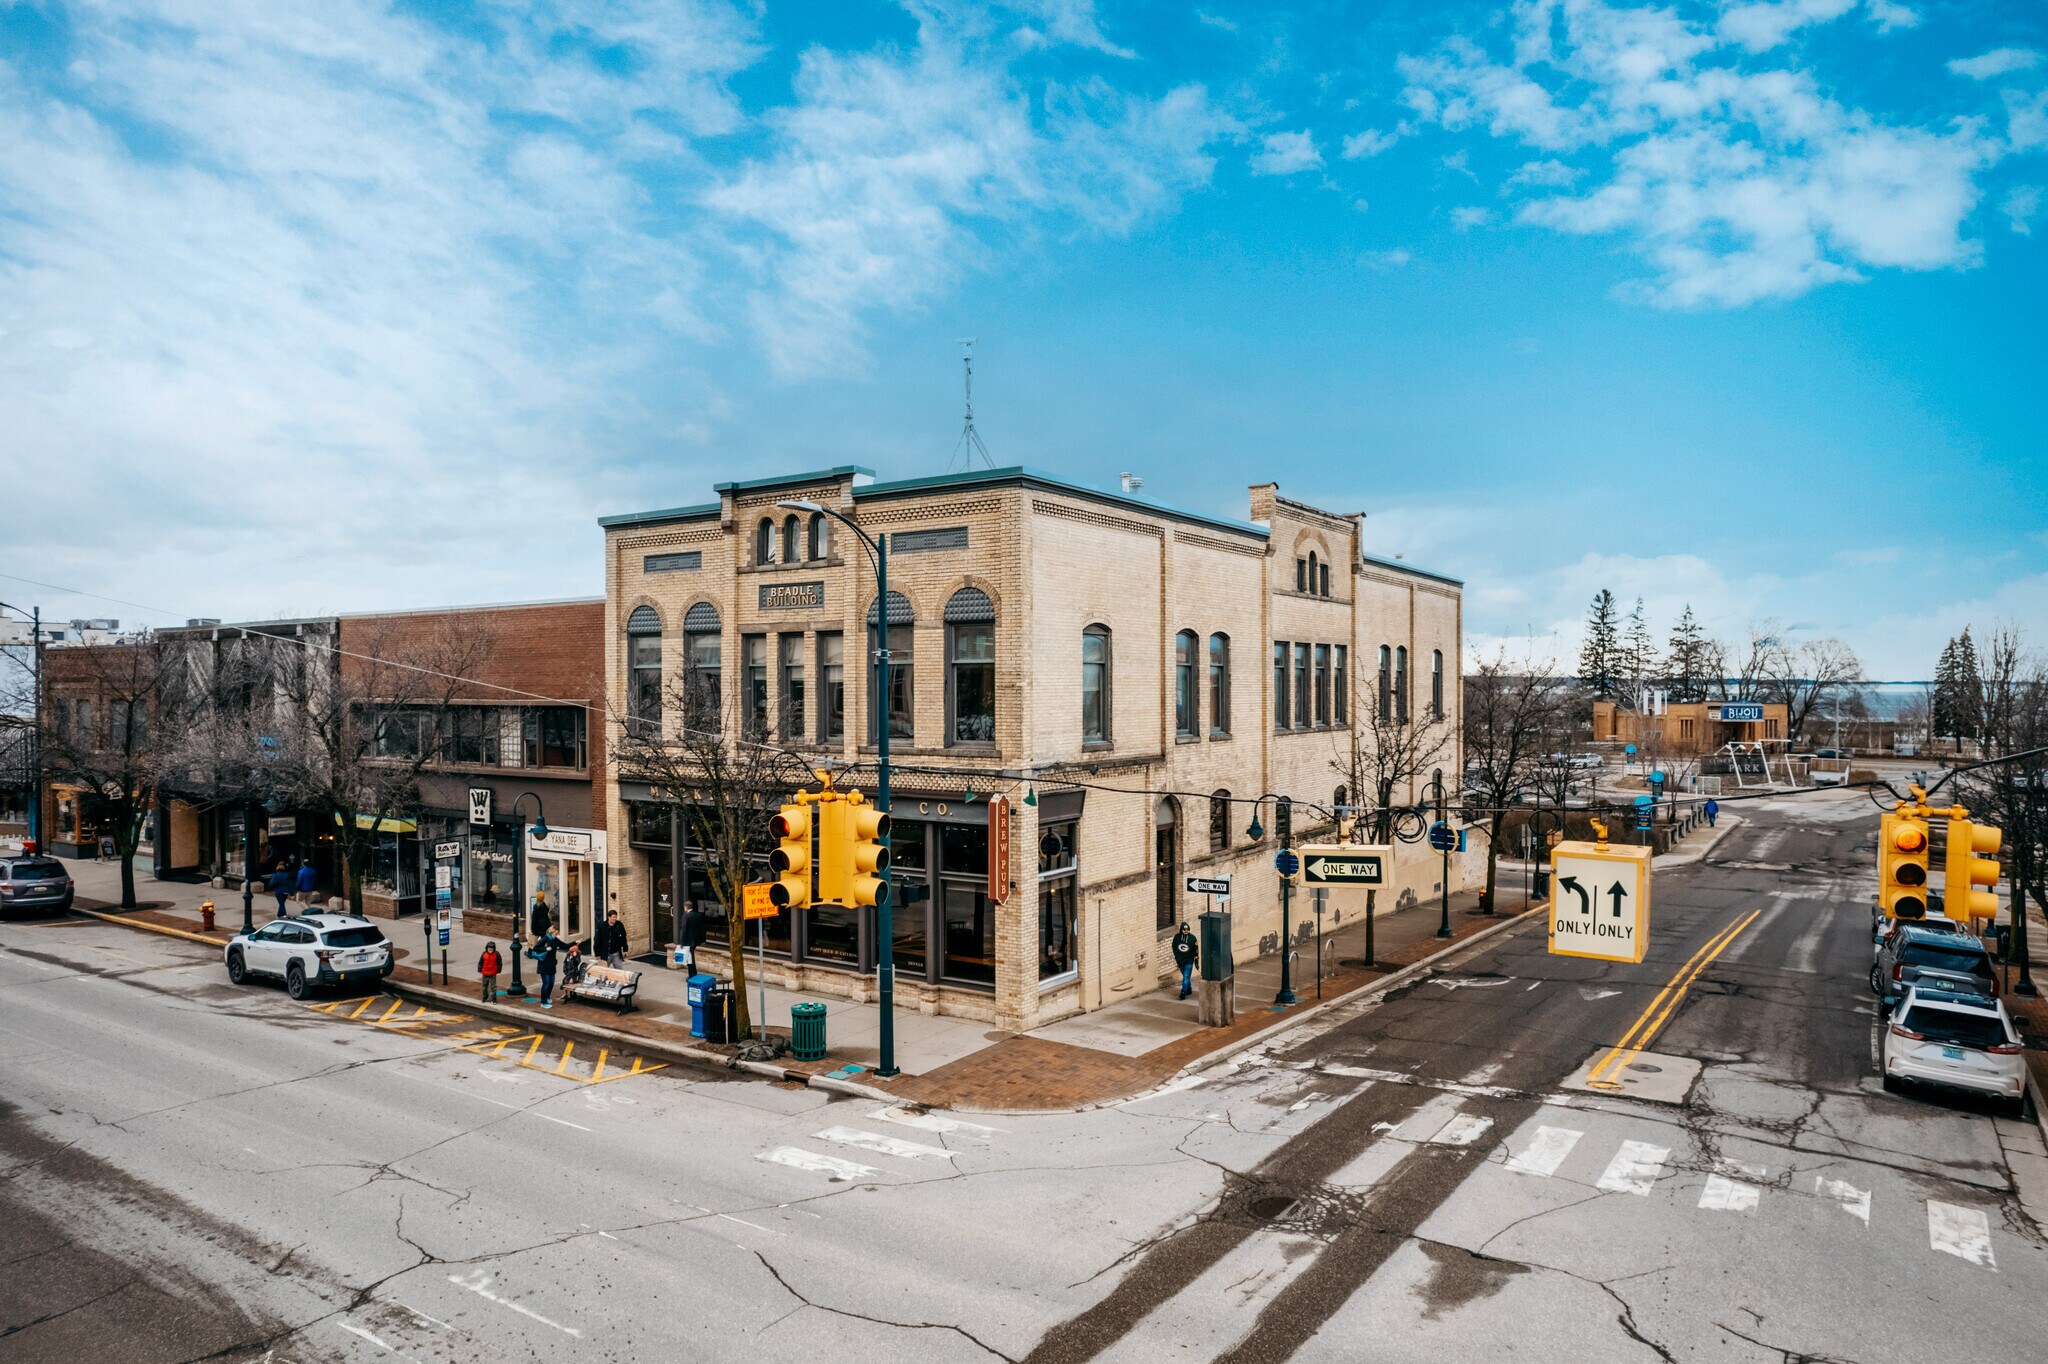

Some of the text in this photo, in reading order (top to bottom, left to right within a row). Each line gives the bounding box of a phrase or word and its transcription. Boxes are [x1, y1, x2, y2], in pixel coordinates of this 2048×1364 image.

[771, 585, 814, 597] BEADLE
[767, 595, 817, 607] BUILDING
[1729, 708, 1758, 719] BIJOU
[1729, 763, 1760, 773] PARK
[650, 786, 761, 804] MACKINW
[918, 801, 953, 818] CO.
[1000, 805, 1008, 853] BREW
[551, 834, 577, 846] YANA DEE
[1322, 864, 1374, 875] ONE WAY
[1557, 920, 1633, 939] ONLY ONLY
